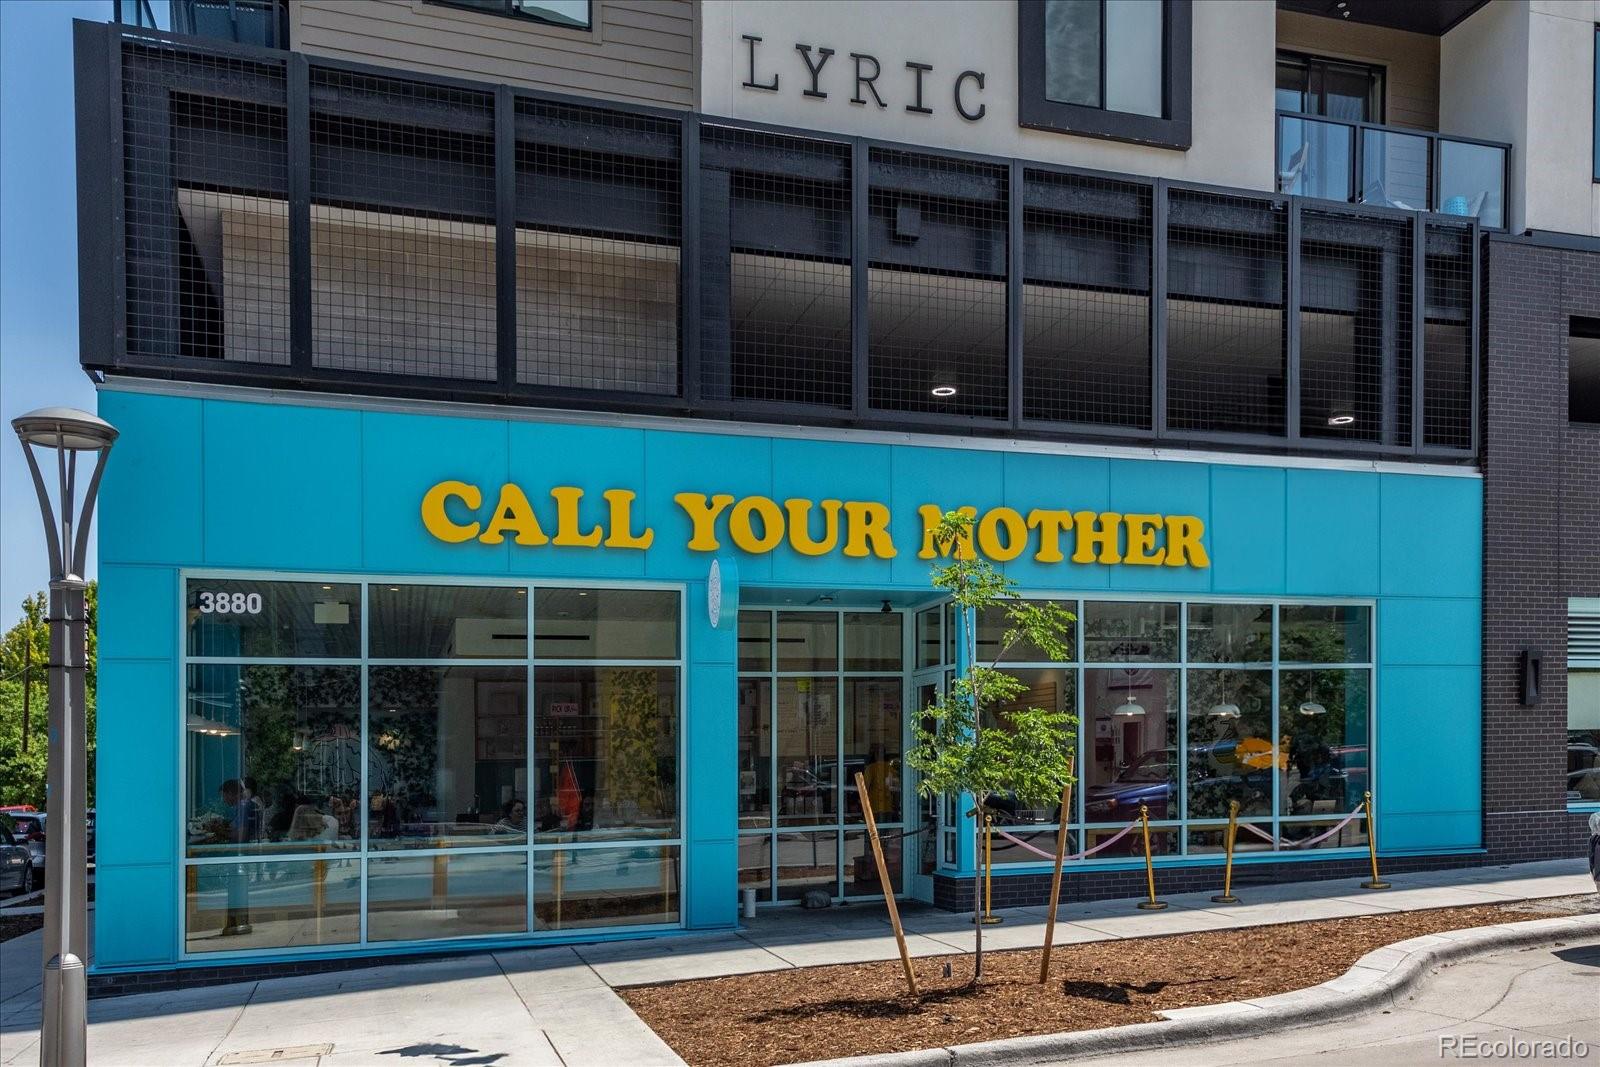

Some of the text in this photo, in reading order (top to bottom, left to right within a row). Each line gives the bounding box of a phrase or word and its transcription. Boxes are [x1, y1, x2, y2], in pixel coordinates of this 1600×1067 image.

[742, 34, 985, 120] LYRIC
[421, 480, 1210, 568] CALL YOUR MOTHER
[200, 592, 262, 614] 3880
